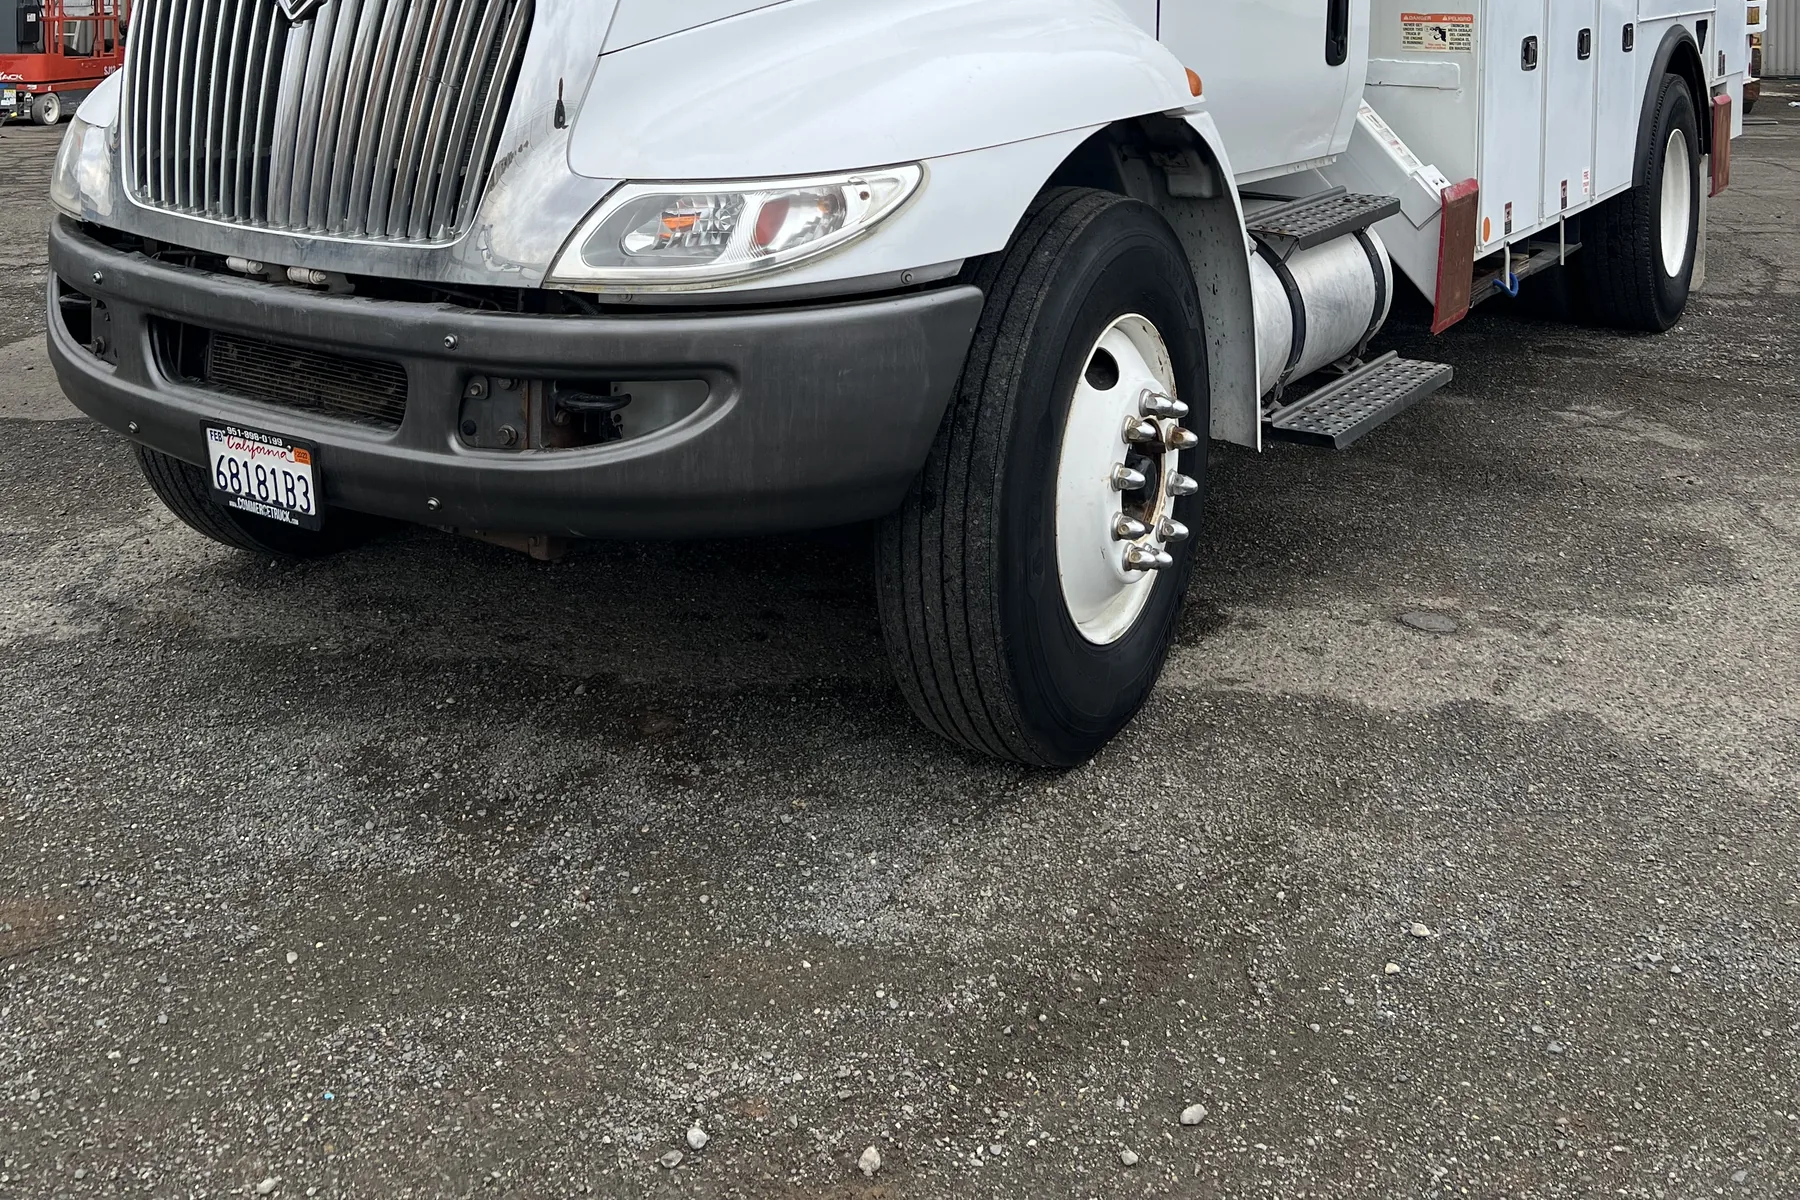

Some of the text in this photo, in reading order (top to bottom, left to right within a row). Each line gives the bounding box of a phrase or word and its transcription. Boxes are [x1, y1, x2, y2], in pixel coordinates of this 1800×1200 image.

[209, 429, 223, 442] FEB
[226, 426, 283, 447] 951-898-0199
[226, 435, 296, 463] California
[216, 454, 310, 514] 68181B3
